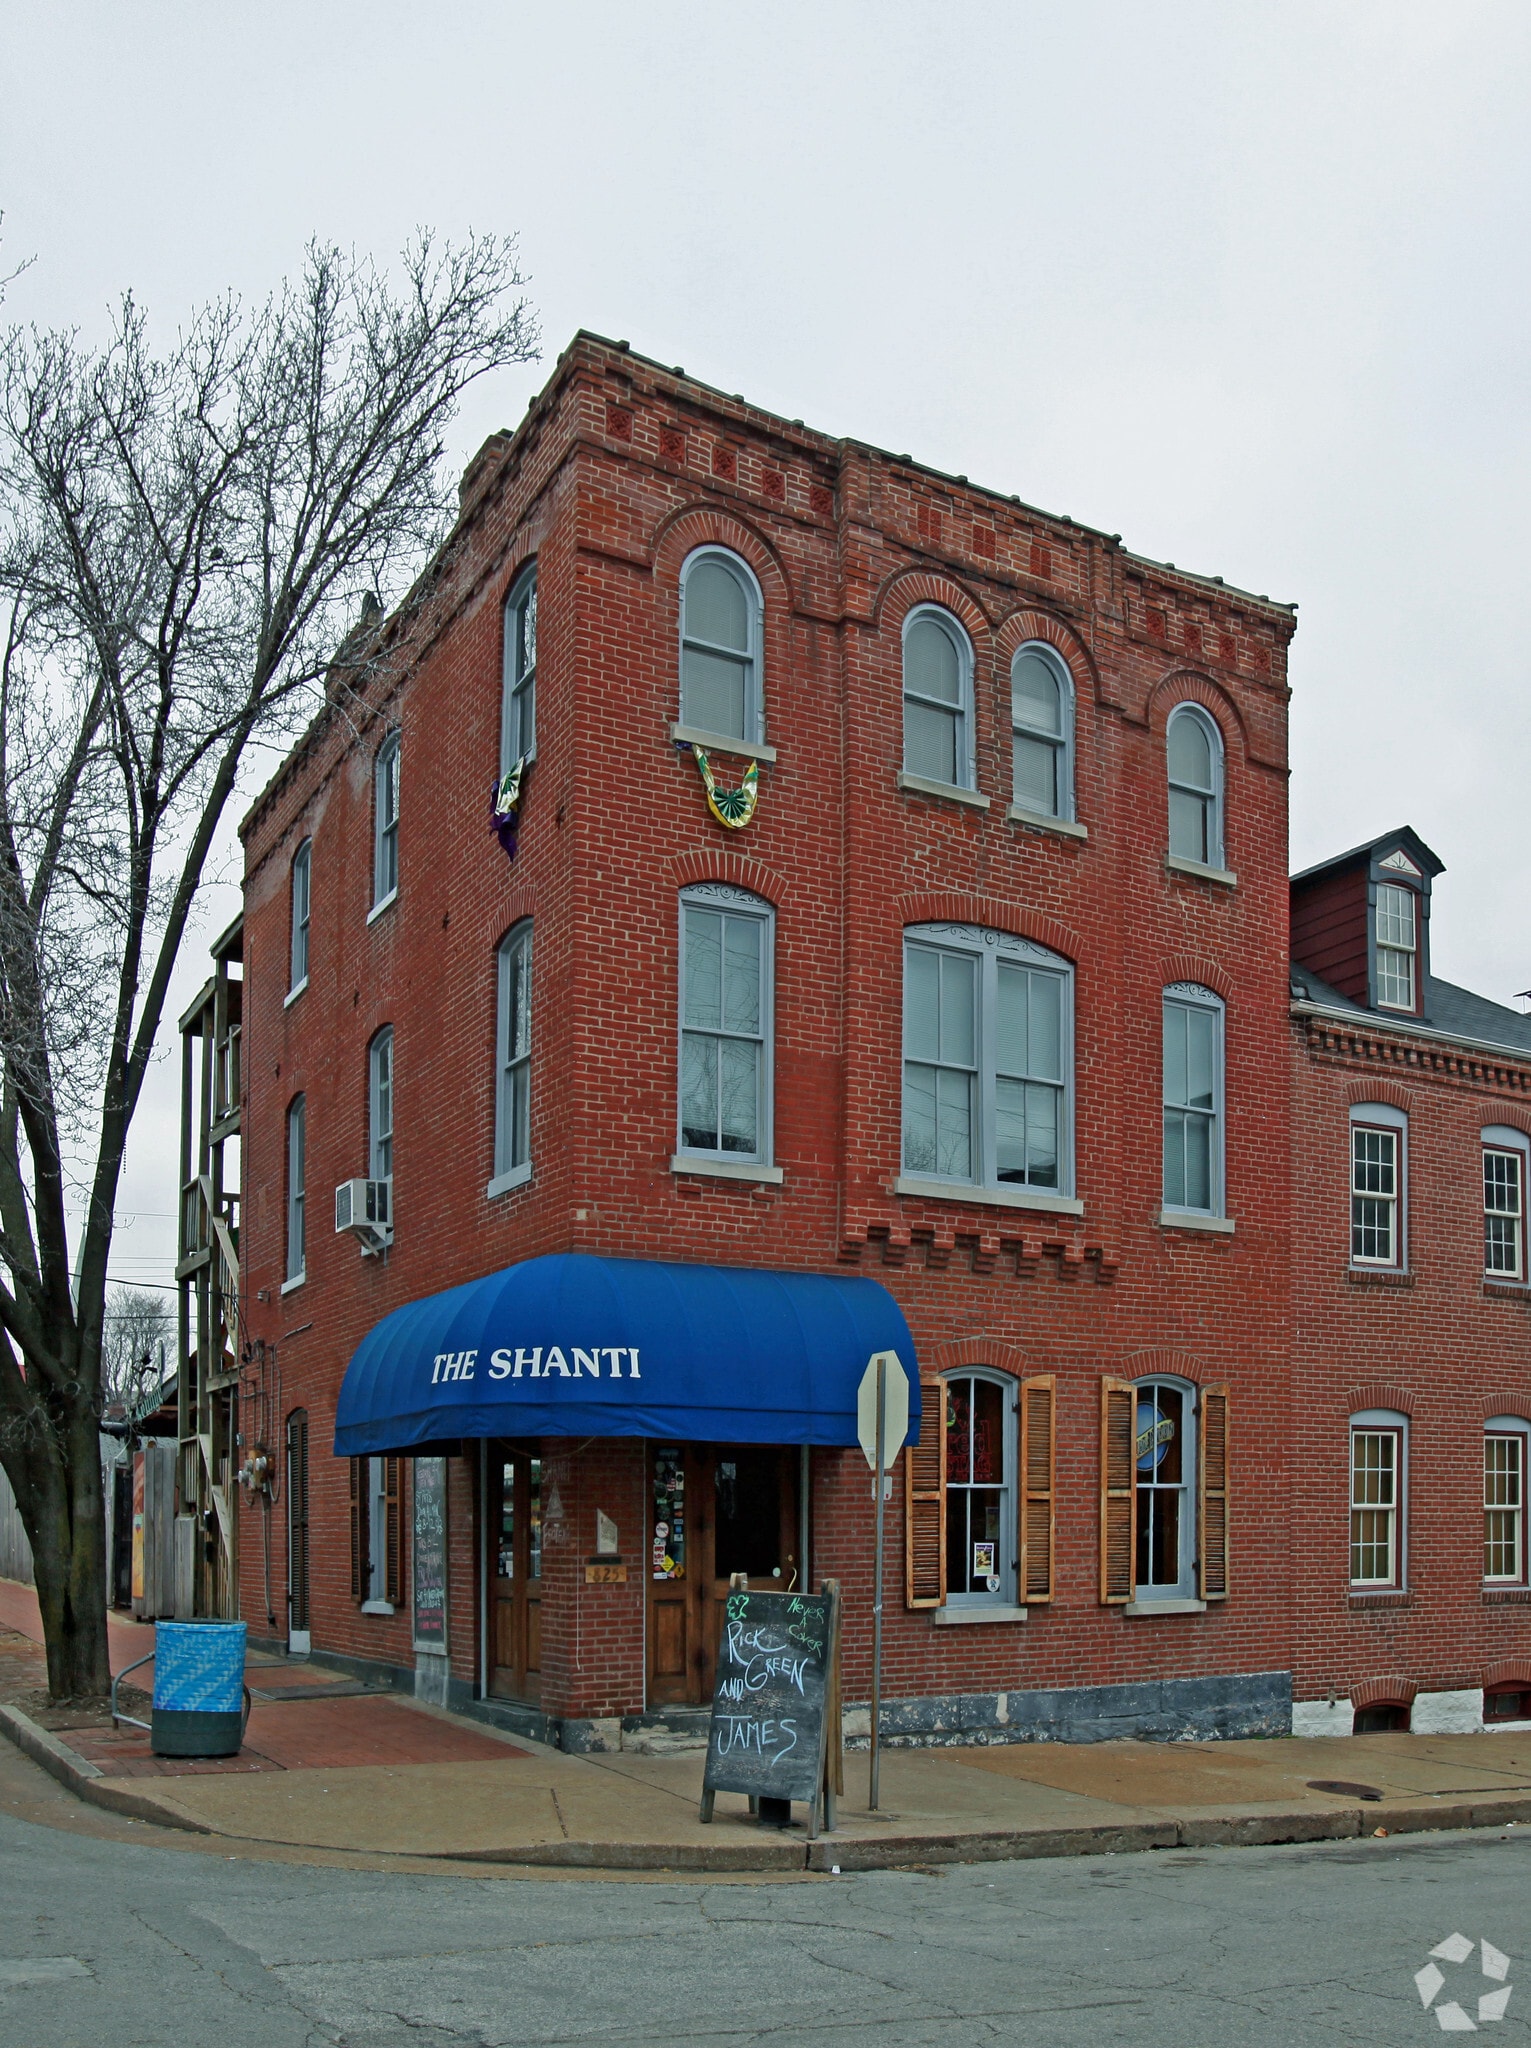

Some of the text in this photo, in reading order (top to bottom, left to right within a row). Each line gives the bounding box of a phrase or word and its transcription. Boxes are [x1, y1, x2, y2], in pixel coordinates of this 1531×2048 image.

[431, 1346, 641, 1384] THE SHANTI
[593, 1567, 619, 1582] 825
[719, 1678, 743, 1701] AND
[745, 1654, 808, 1696] GREEN
[715, 1715, 796, 1767] JAMES
